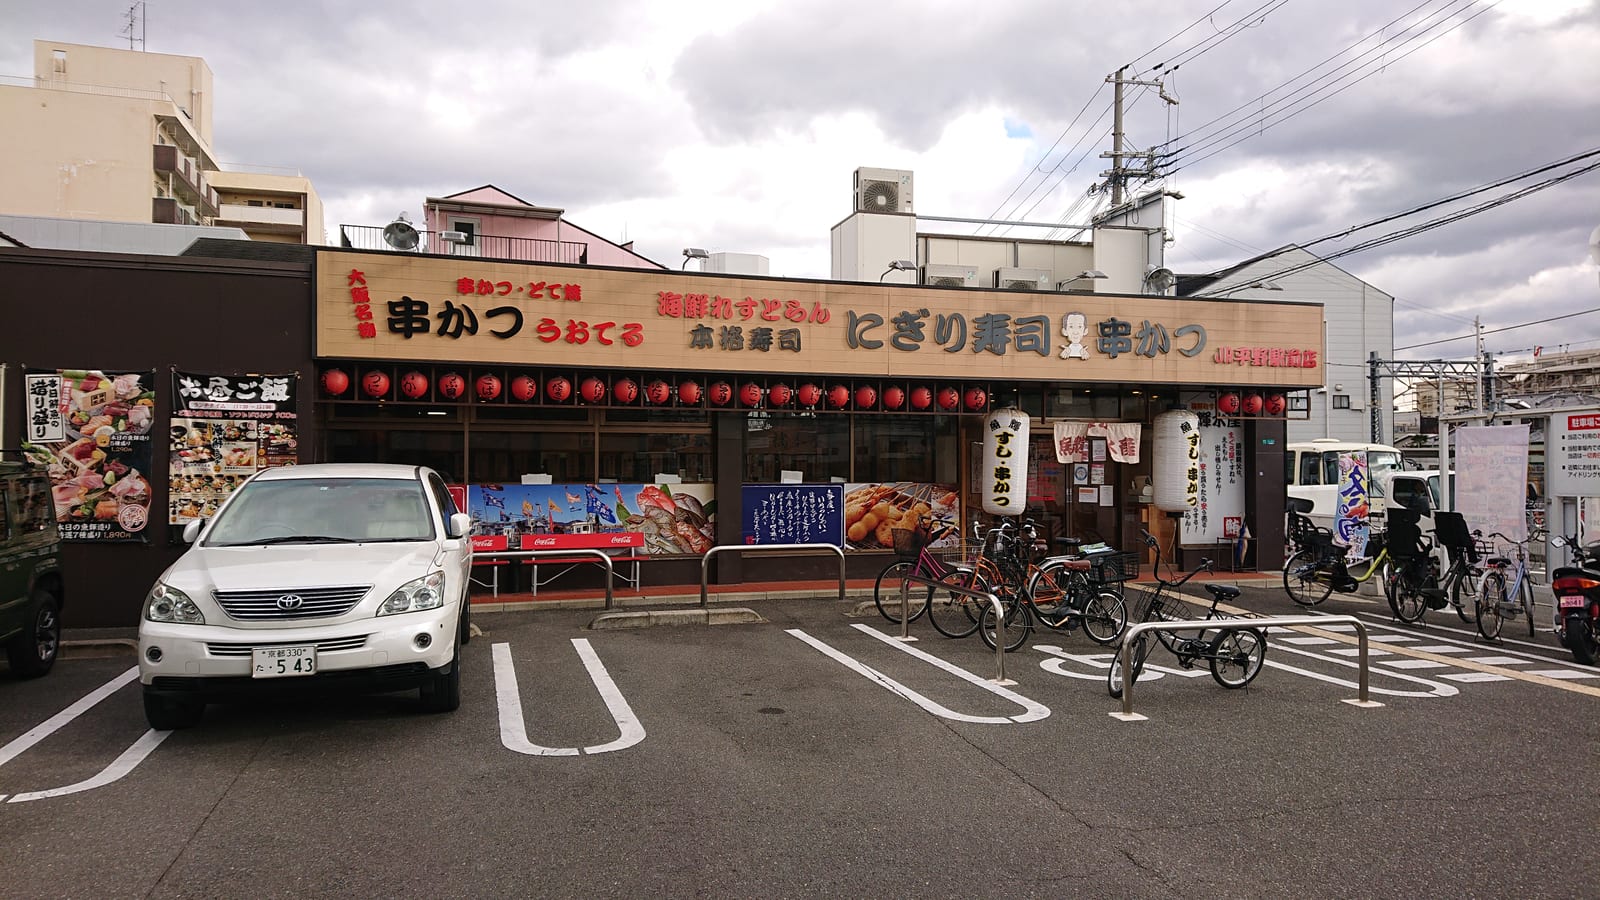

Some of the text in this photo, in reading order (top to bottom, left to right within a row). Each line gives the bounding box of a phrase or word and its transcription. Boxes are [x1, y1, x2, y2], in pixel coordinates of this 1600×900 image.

[347, 268, 377, 339] 大阪名物
[387, 296, 524, 339] 串かつ
[657, 290, 831, 324] 海鮮れすとらん
[536, 318, 645, 347] うおてる
[690, 324, 803, 352] 本格寿司
[847, 308, 1207, 358] にぎり寿司 串かつ
[1214, 346, 1317, 369] JR平野駅前店
[30, 379, 50, 438] 造り盛り
[47, 378, 61, 428] 本日鮮魚の
[180, 376, 290, 401] お昼ご飯
[989, 418, 1022, 432] 魚輝
[992, 431, 1015, 508] すし・串かつ
[1186, 433, 1200, 508] すし・串かつ
